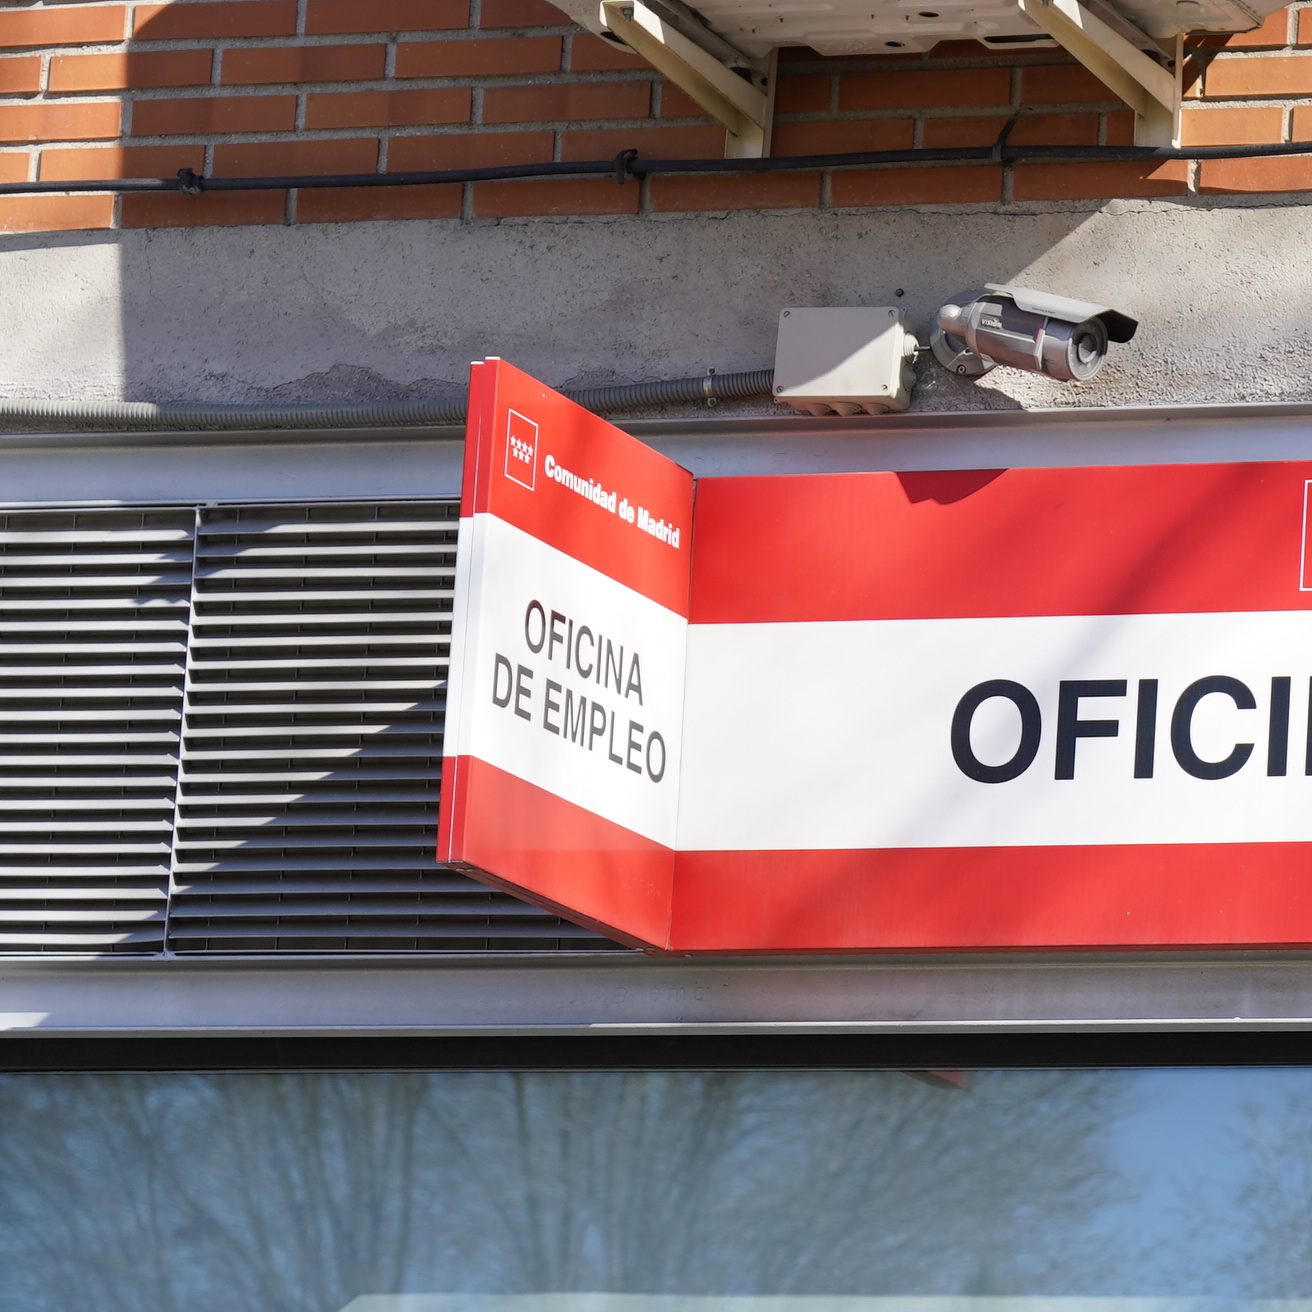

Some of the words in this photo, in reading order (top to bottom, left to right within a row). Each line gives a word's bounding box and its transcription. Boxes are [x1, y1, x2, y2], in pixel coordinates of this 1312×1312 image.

[544, 454, 617, 516] Comunidad
[619, 495, 635, 525] de
[638, 506, 680, 549] Madrid
[524, 599, 643, 705] OFICINA
[492, 652, 532, 722] DE
[543, 680, 667, 784] EMPLEO
